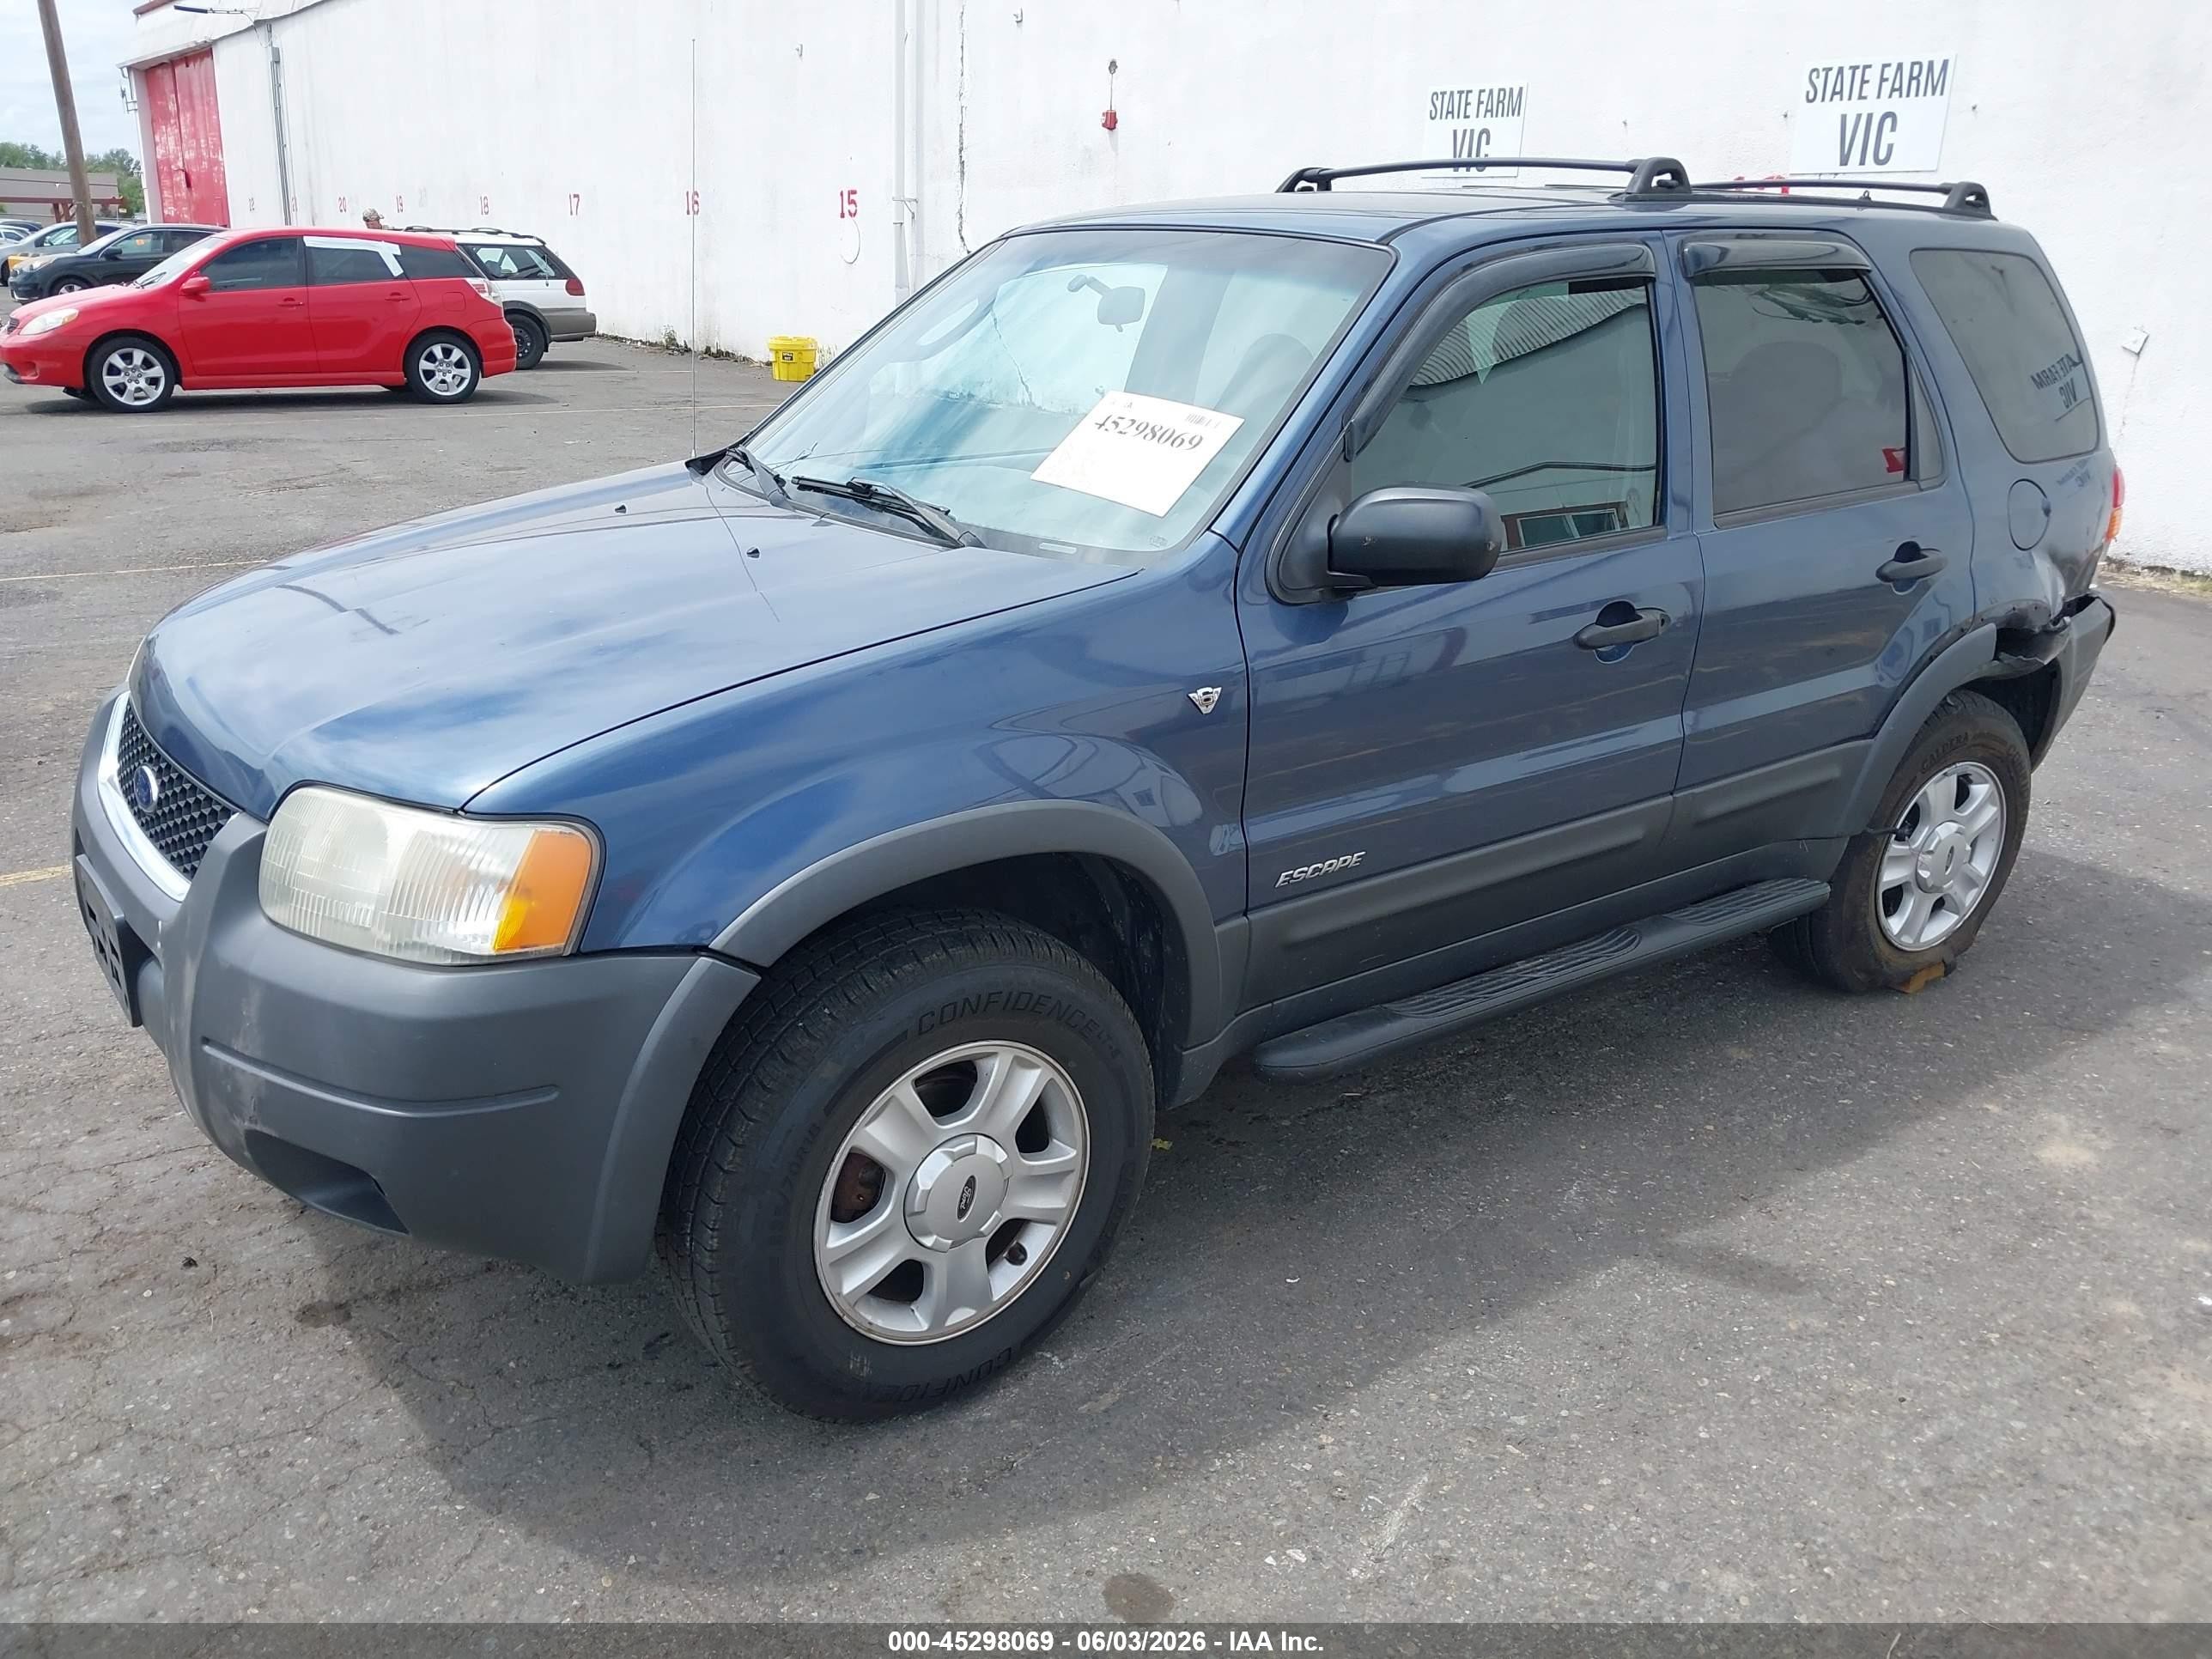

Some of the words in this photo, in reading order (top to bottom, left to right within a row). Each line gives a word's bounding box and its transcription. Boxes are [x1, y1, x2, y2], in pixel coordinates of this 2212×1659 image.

[1805, 64, 1873, 104] STATE
[1876, 58, 1949, 100] FARM
[1429, 89, 1474, 120] STATE
[1475, 86, 1523, 118] FARM
[1452, 127, 1491, 173] VIC
[1839, 111, 1898, 167] VIC
[338, 196, 347, 213] 20
[396, 195, 404, 214] 19
[480, 195, 489, 216] 18
[568, 193, 580, 216] 17
[686, 190, 700, 216] 16
[840, 189, 858, 219] 15
[1093, 414, 1204, 451] 45298069
[1274, 851, 1366, 889] ESCAPE
[916, 990, 1100, 1039] CONFIDENCE
